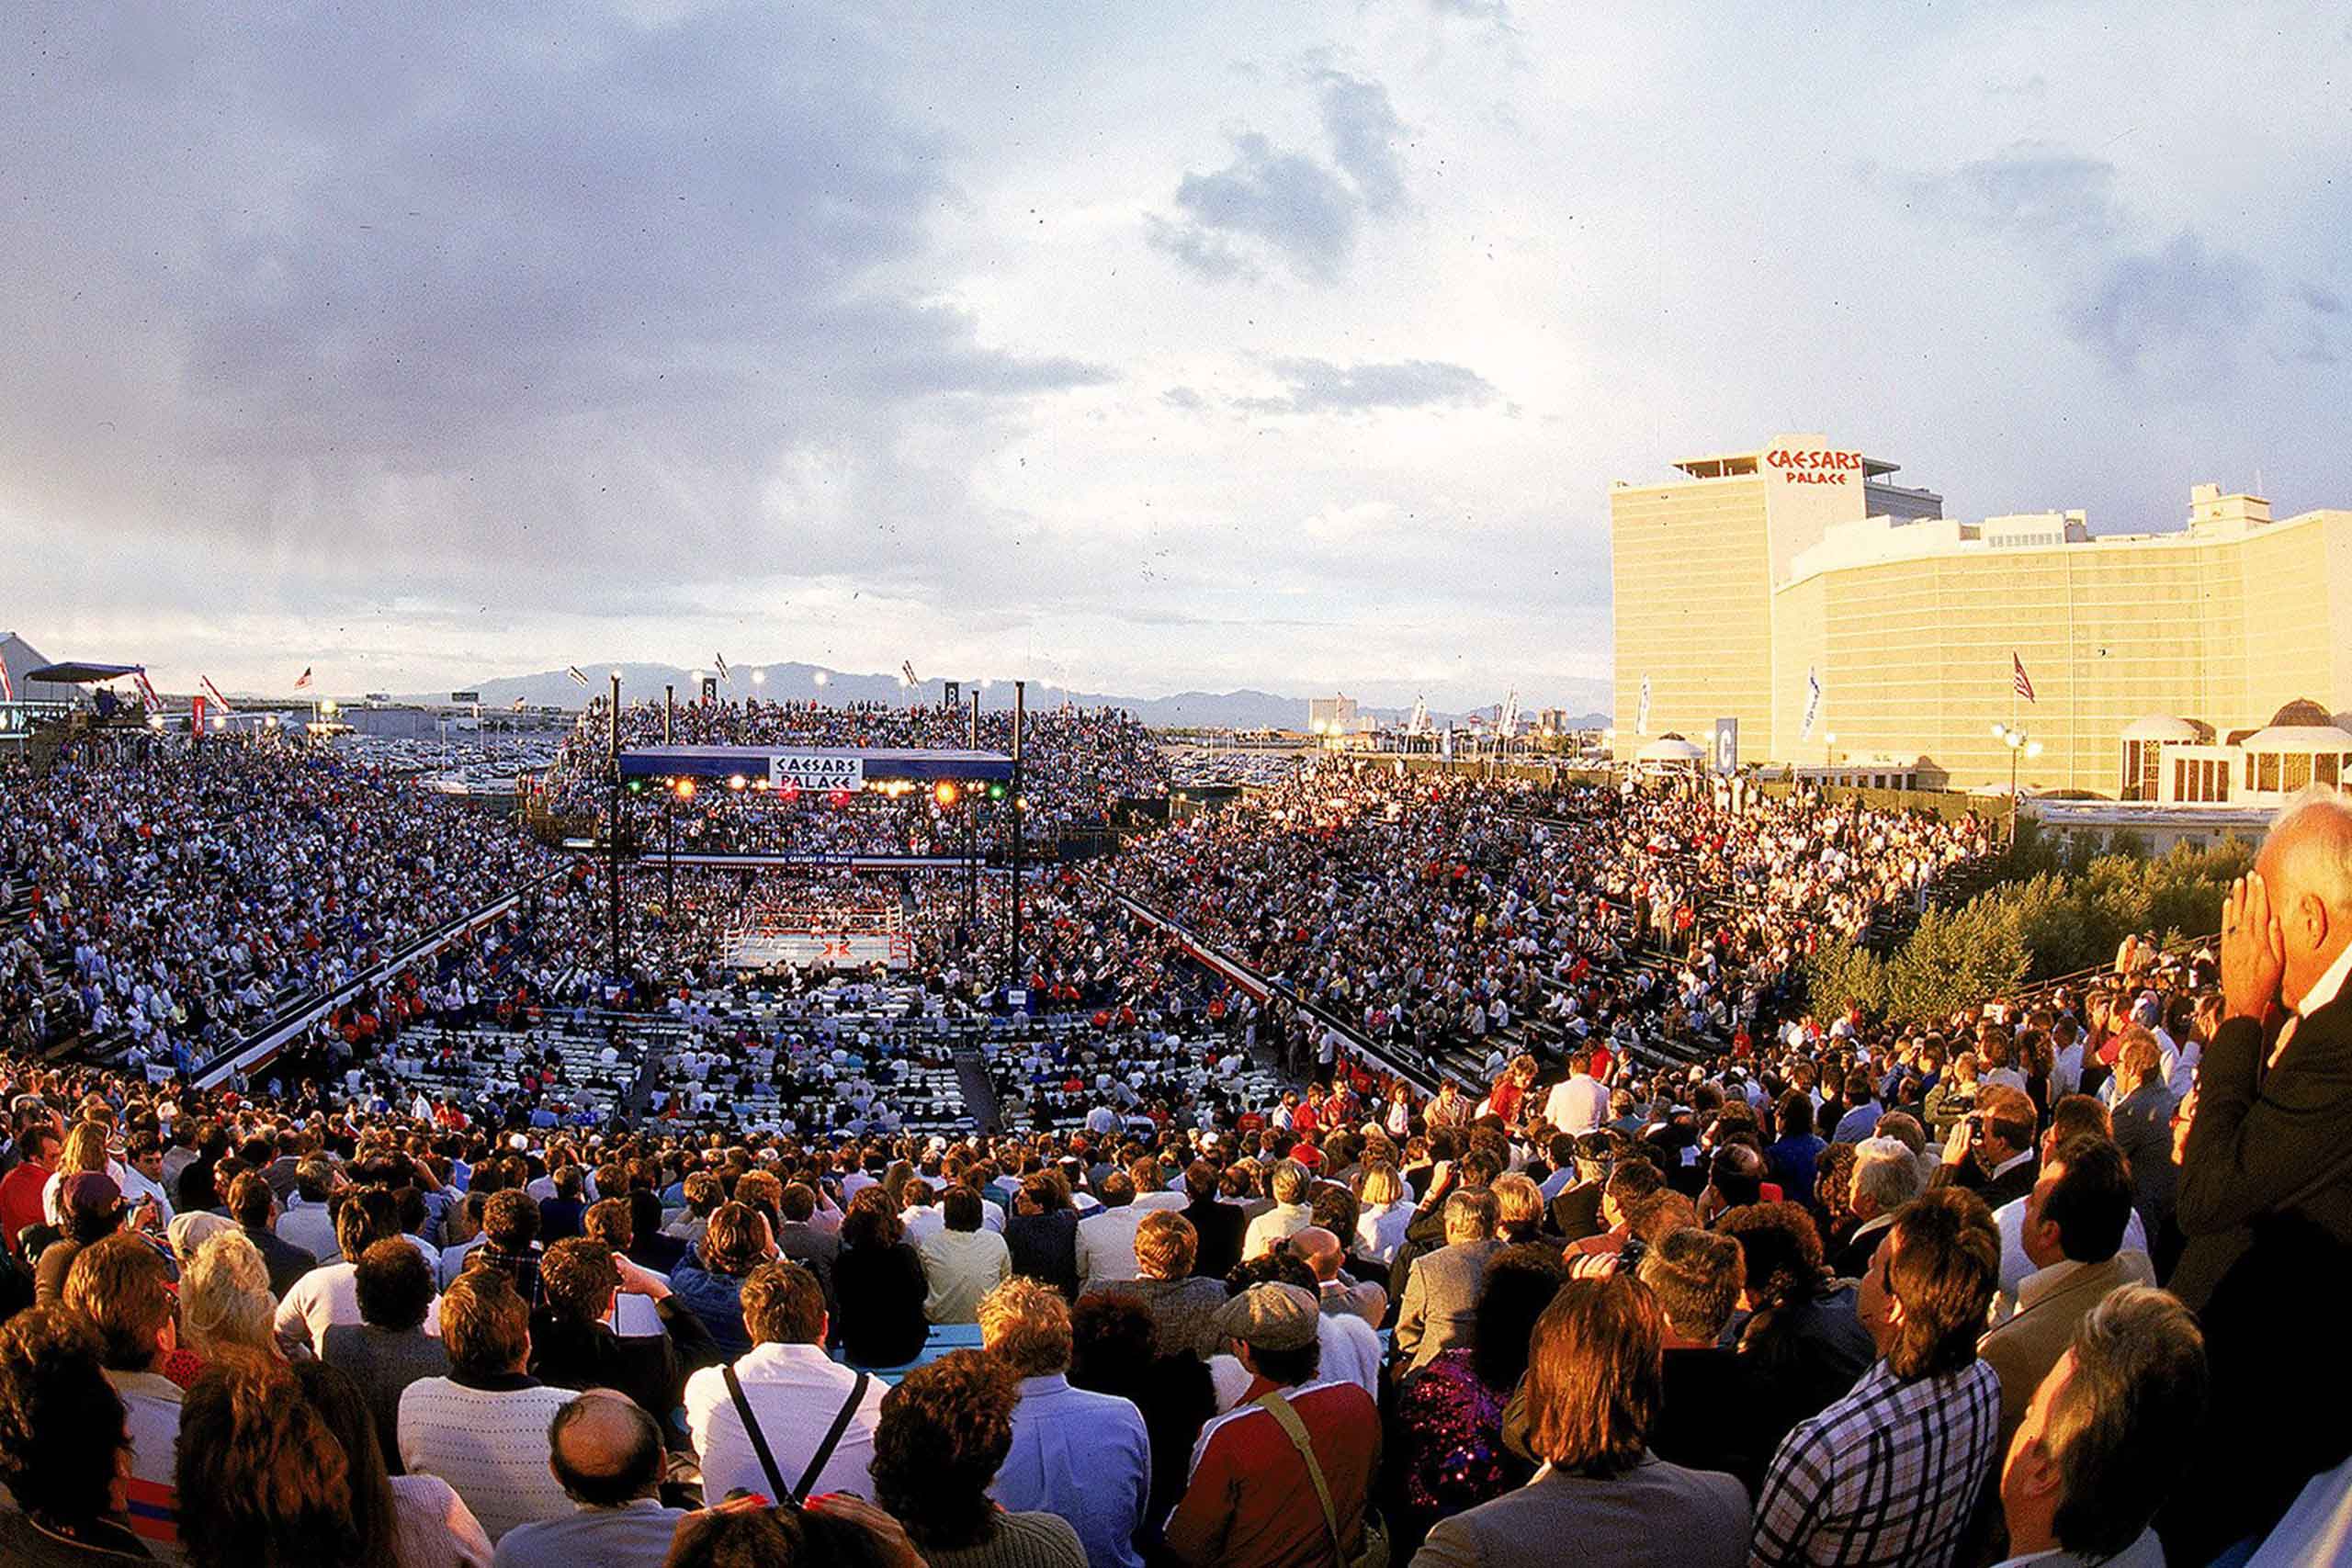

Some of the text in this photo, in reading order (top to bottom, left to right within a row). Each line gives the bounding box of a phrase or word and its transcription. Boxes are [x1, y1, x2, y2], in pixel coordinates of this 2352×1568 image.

[1767, 450, 1860, 469] CAESARS
[1786, 472, 1847, 485] PALACE
[1720, 728, 1731, 768] C
[776, 758, 855, 772] CAESARS
[782, 775, 851, 788] PALACE
